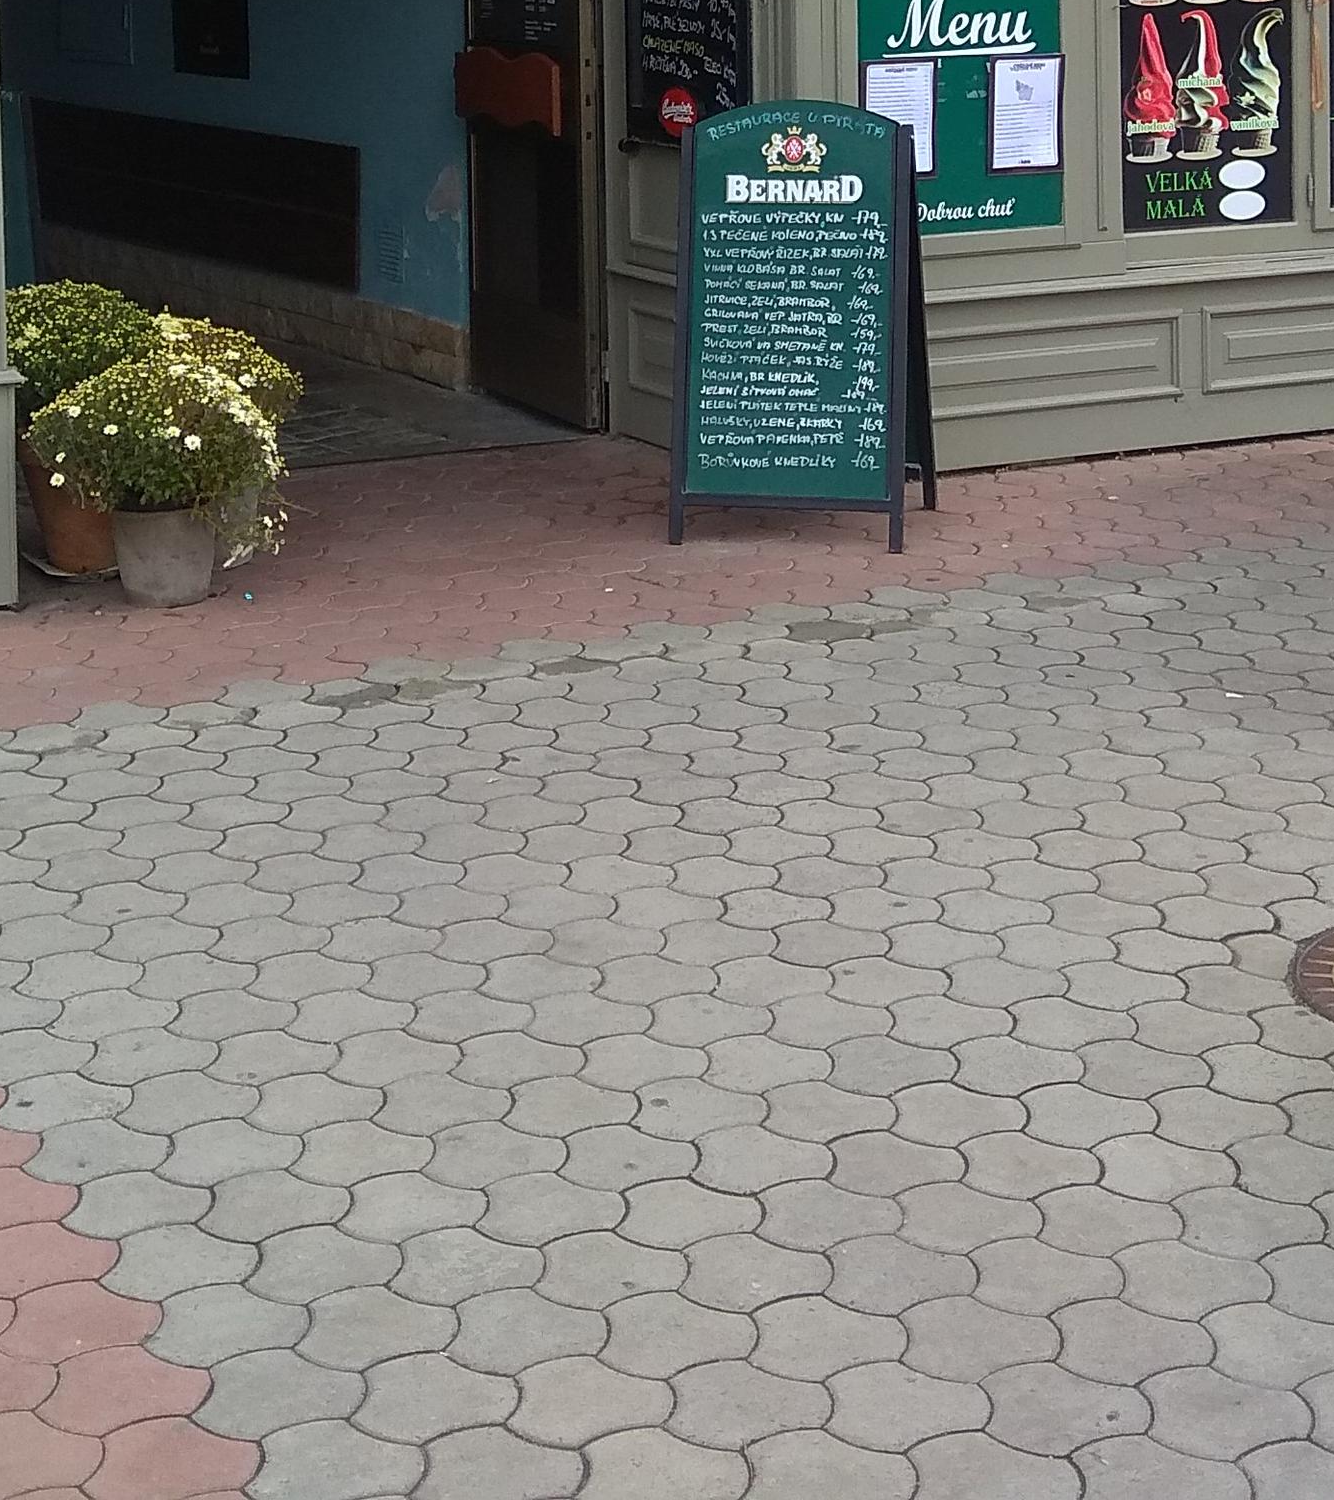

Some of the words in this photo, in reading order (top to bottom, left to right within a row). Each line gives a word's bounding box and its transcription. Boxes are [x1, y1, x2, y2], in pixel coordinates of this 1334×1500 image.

[707, 111, 800, 141] RESTAURACE
[1146, 167, 1213, 193] VELKÁ
[977, 197, 1016, 218] chuť
[1146, 194, 1206, 220] MALÁ
